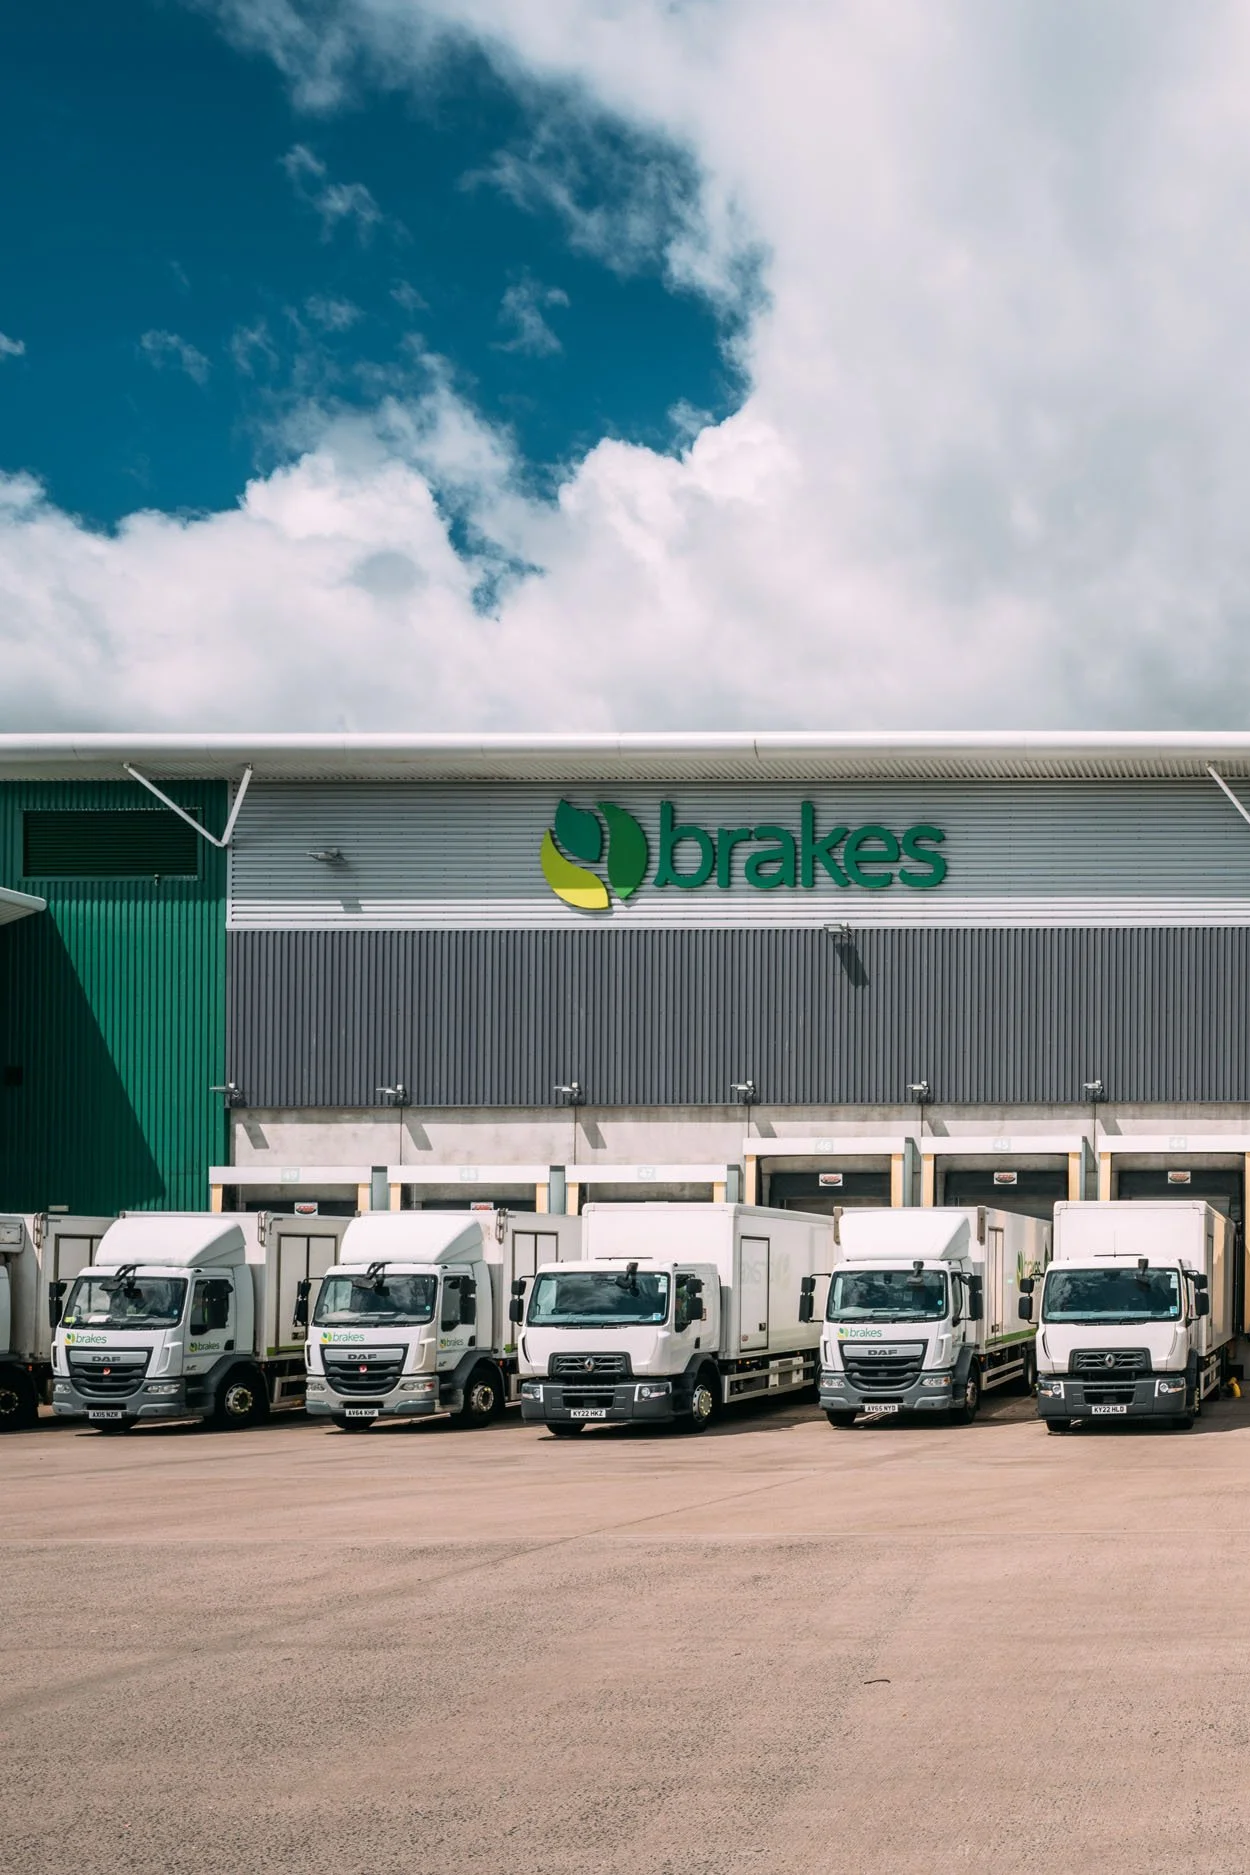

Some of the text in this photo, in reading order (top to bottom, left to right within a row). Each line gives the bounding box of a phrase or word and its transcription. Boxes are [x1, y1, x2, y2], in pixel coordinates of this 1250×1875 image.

[653, 800, 947, 888] brakes
[333, 1332, 365, 1342] brakes
[849, 1327, 882, 1338] brakes
[76, 1333, 107, 1344] brakes
[446, 1338, 464, 1347] brakes
[197, 1341, 220, 1351] brakes
